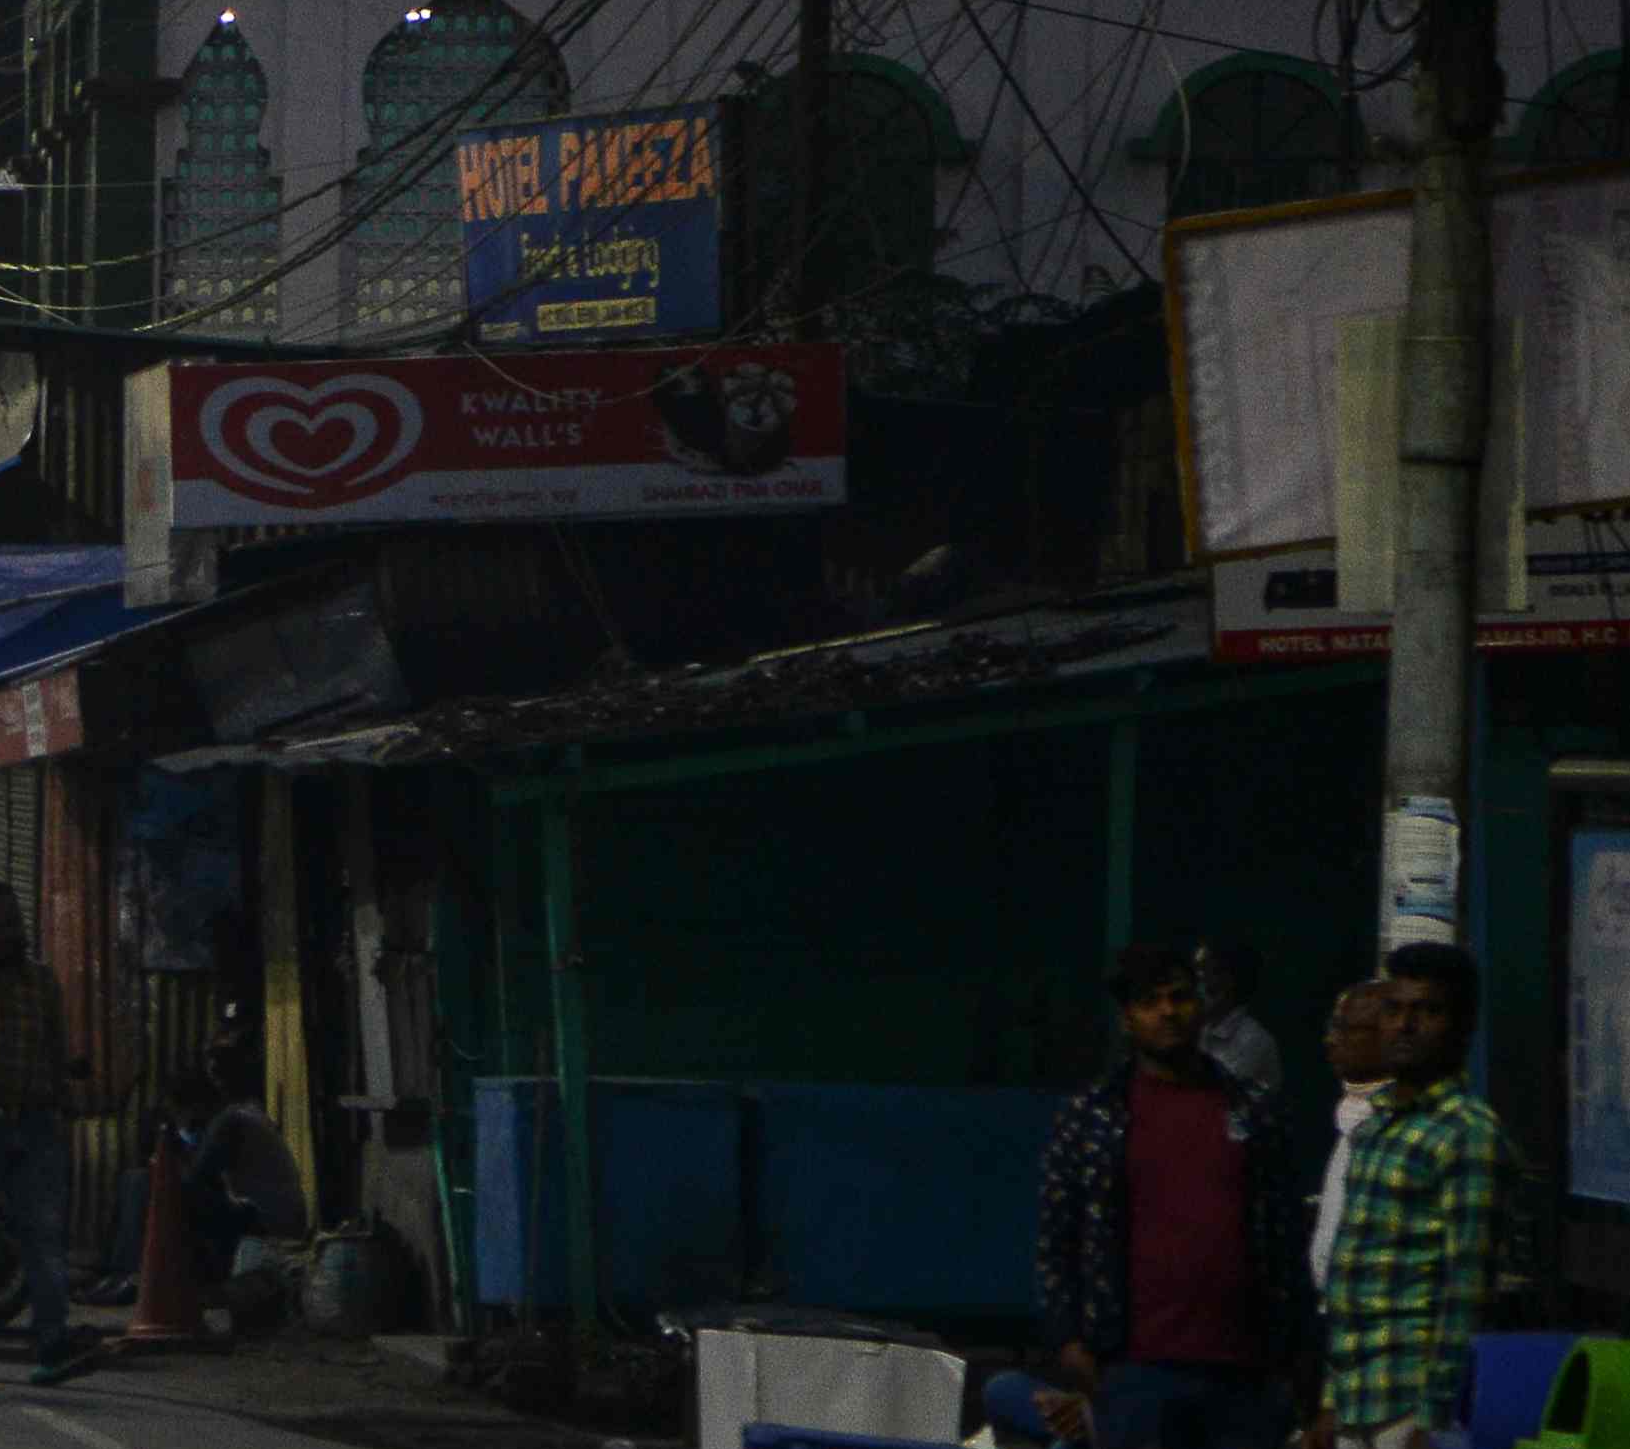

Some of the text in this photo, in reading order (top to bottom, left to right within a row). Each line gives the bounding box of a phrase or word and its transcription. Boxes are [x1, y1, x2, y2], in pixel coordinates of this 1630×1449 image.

[458, 134, 550, 223] HOTEL
[460, 387, 603, 415] KWALITY
[472, 424, 582, 448] WALL'S
[1258, 631, 1326, 653] HOTEL
